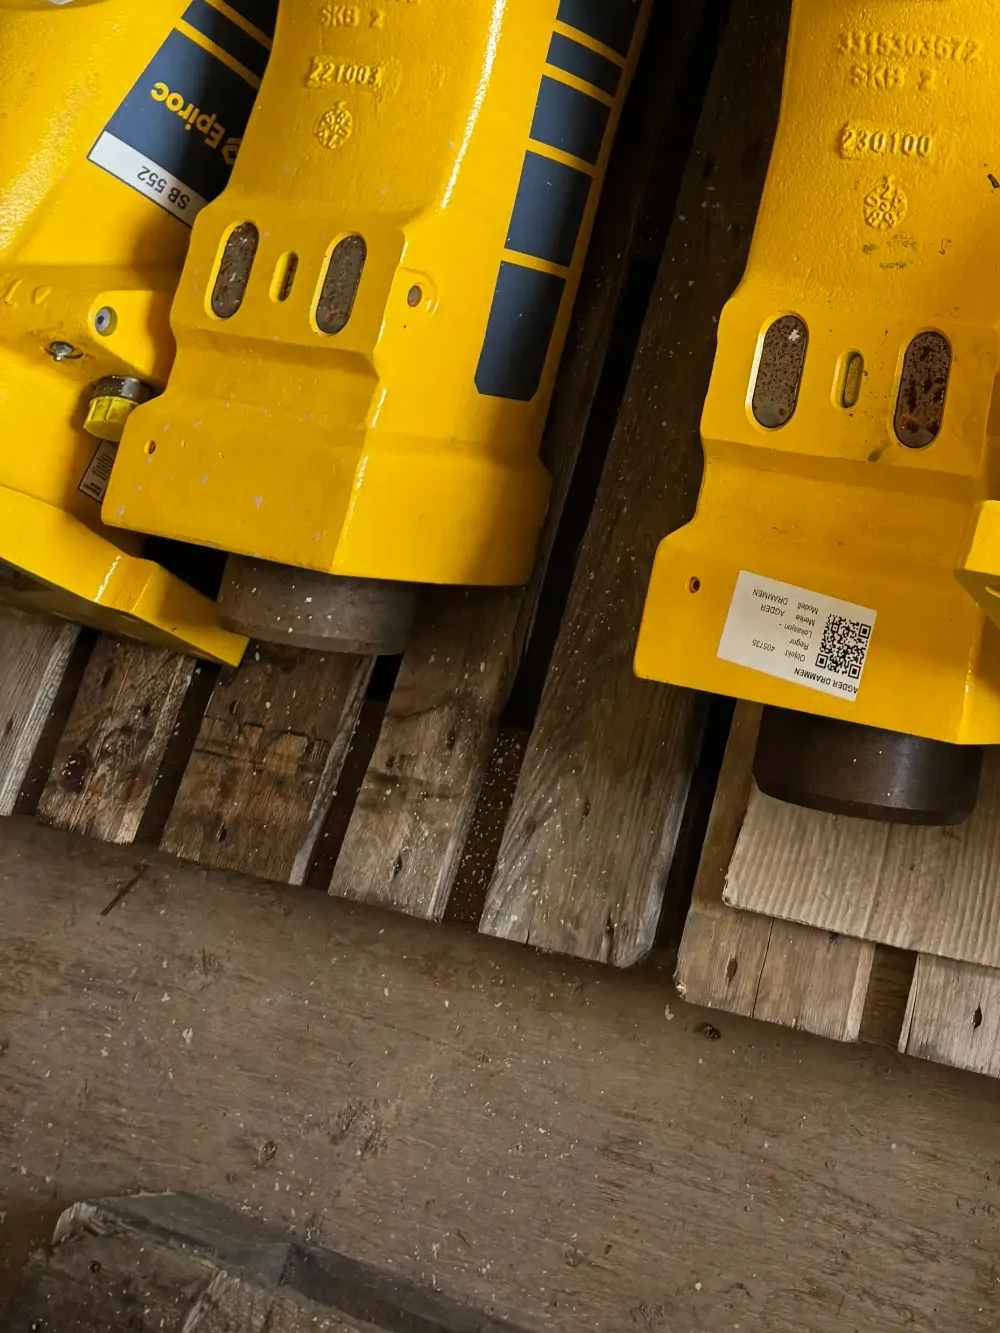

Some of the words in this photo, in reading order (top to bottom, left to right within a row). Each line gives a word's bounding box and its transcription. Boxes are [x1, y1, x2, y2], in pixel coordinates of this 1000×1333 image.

[151, 82, 226, 150] Epiroc
[137, 165, 168, 194] 552
[167, 187, 191, 210] SB
[752, 588, 789, 606] DRAMMEN
[760, 603, 786, 617] AGDER
[795, 614, 816, 627] Merke
[783, 623, 813, 639] Lokasjon
[789, 638, 810, 651] Regnr
[785, 649, 806, 663] Objekt
[794, 667, 831, 686] DRAMMEN
[833, 679, 858, 694] AGDER
